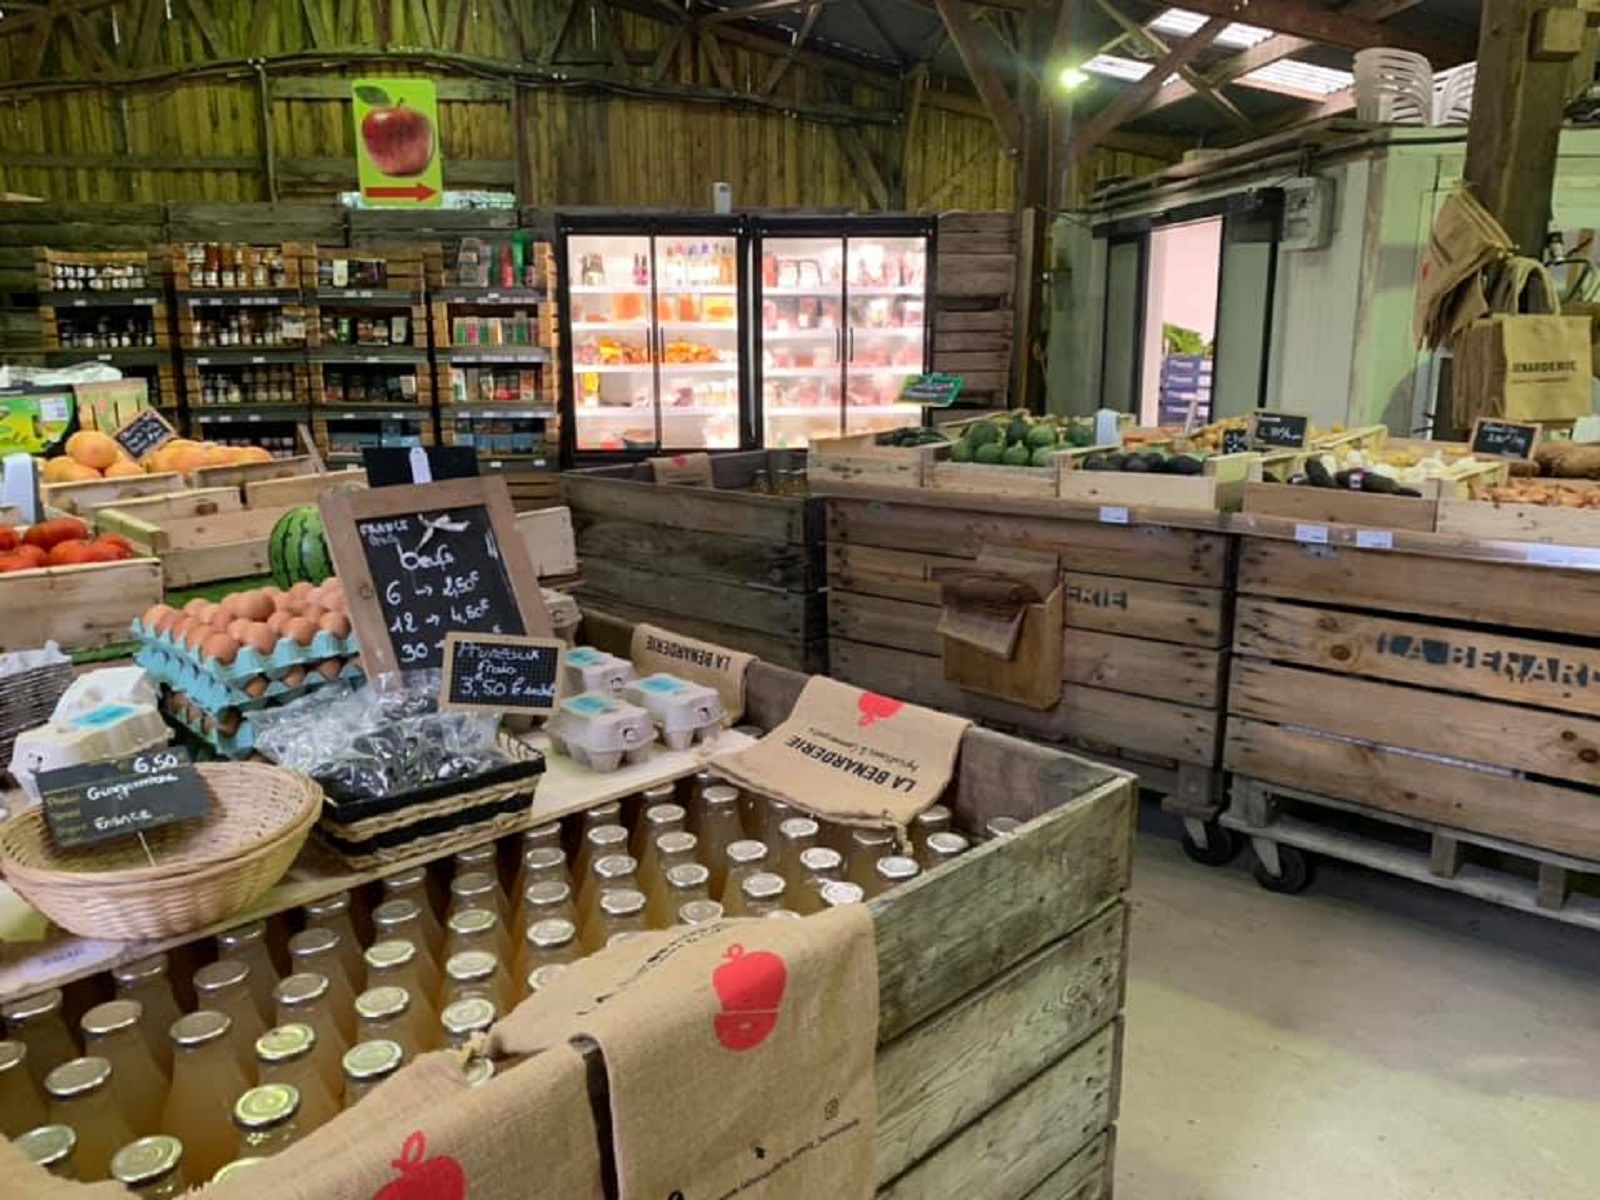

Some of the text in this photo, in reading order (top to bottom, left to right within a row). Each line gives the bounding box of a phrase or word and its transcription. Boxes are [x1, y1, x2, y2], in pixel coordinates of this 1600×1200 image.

[386, 579, 401, 606] 6
[401, 642, 428, 662] 30
[784, 734, 891, 785] BENARDERIE
[892, 774, 917, 793] LA
